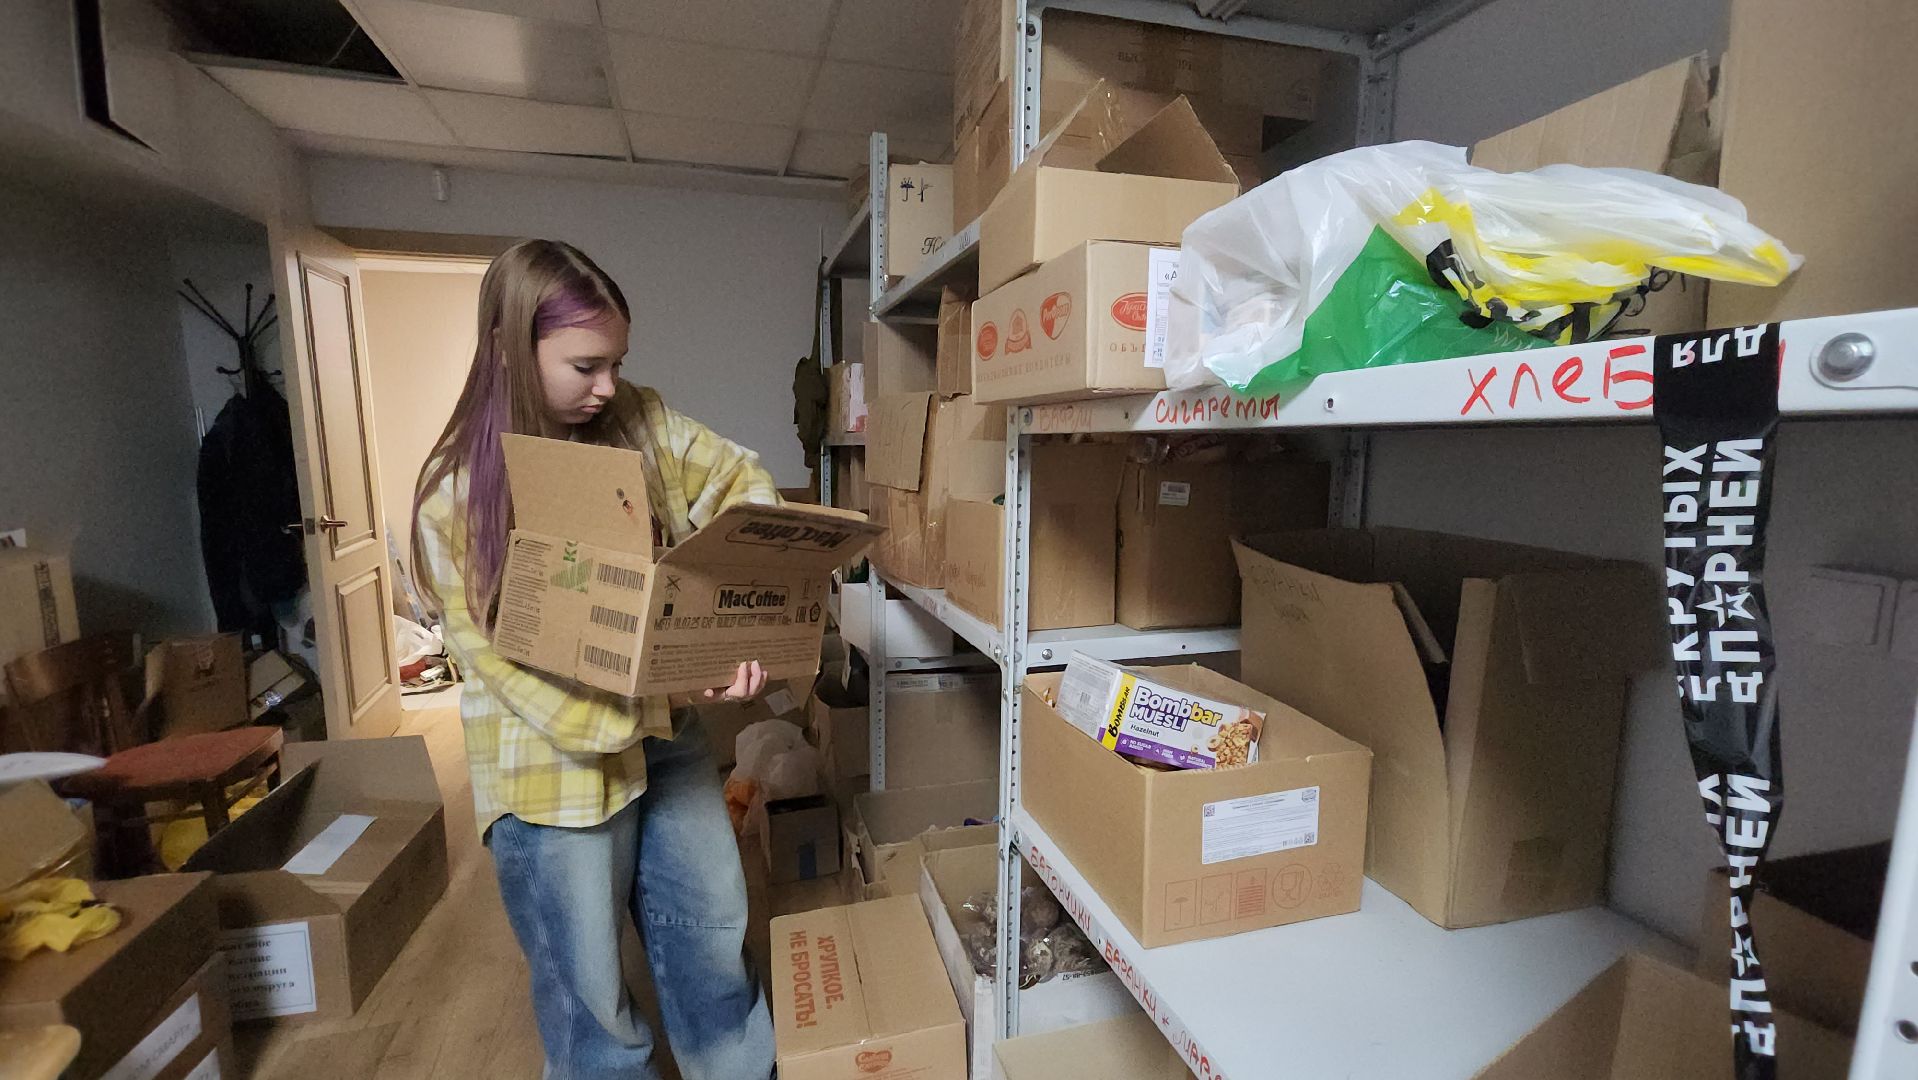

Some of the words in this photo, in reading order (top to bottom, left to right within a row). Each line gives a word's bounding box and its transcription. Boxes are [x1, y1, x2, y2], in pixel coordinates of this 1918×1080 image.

[718, 588, 786, 609] MacCoffee
[1129, 704, 1190, 733] MUESLI
[1132, 685, 1223, 728] Bombbar
[1130, 723, 1160, 738] Hazelnut
[789, 930, 807, 949] НЕ
[817, 935, 844, 1010] ХРУПКОЕ.
[791, 951, 817, 1029] БРОСАТЬ!
